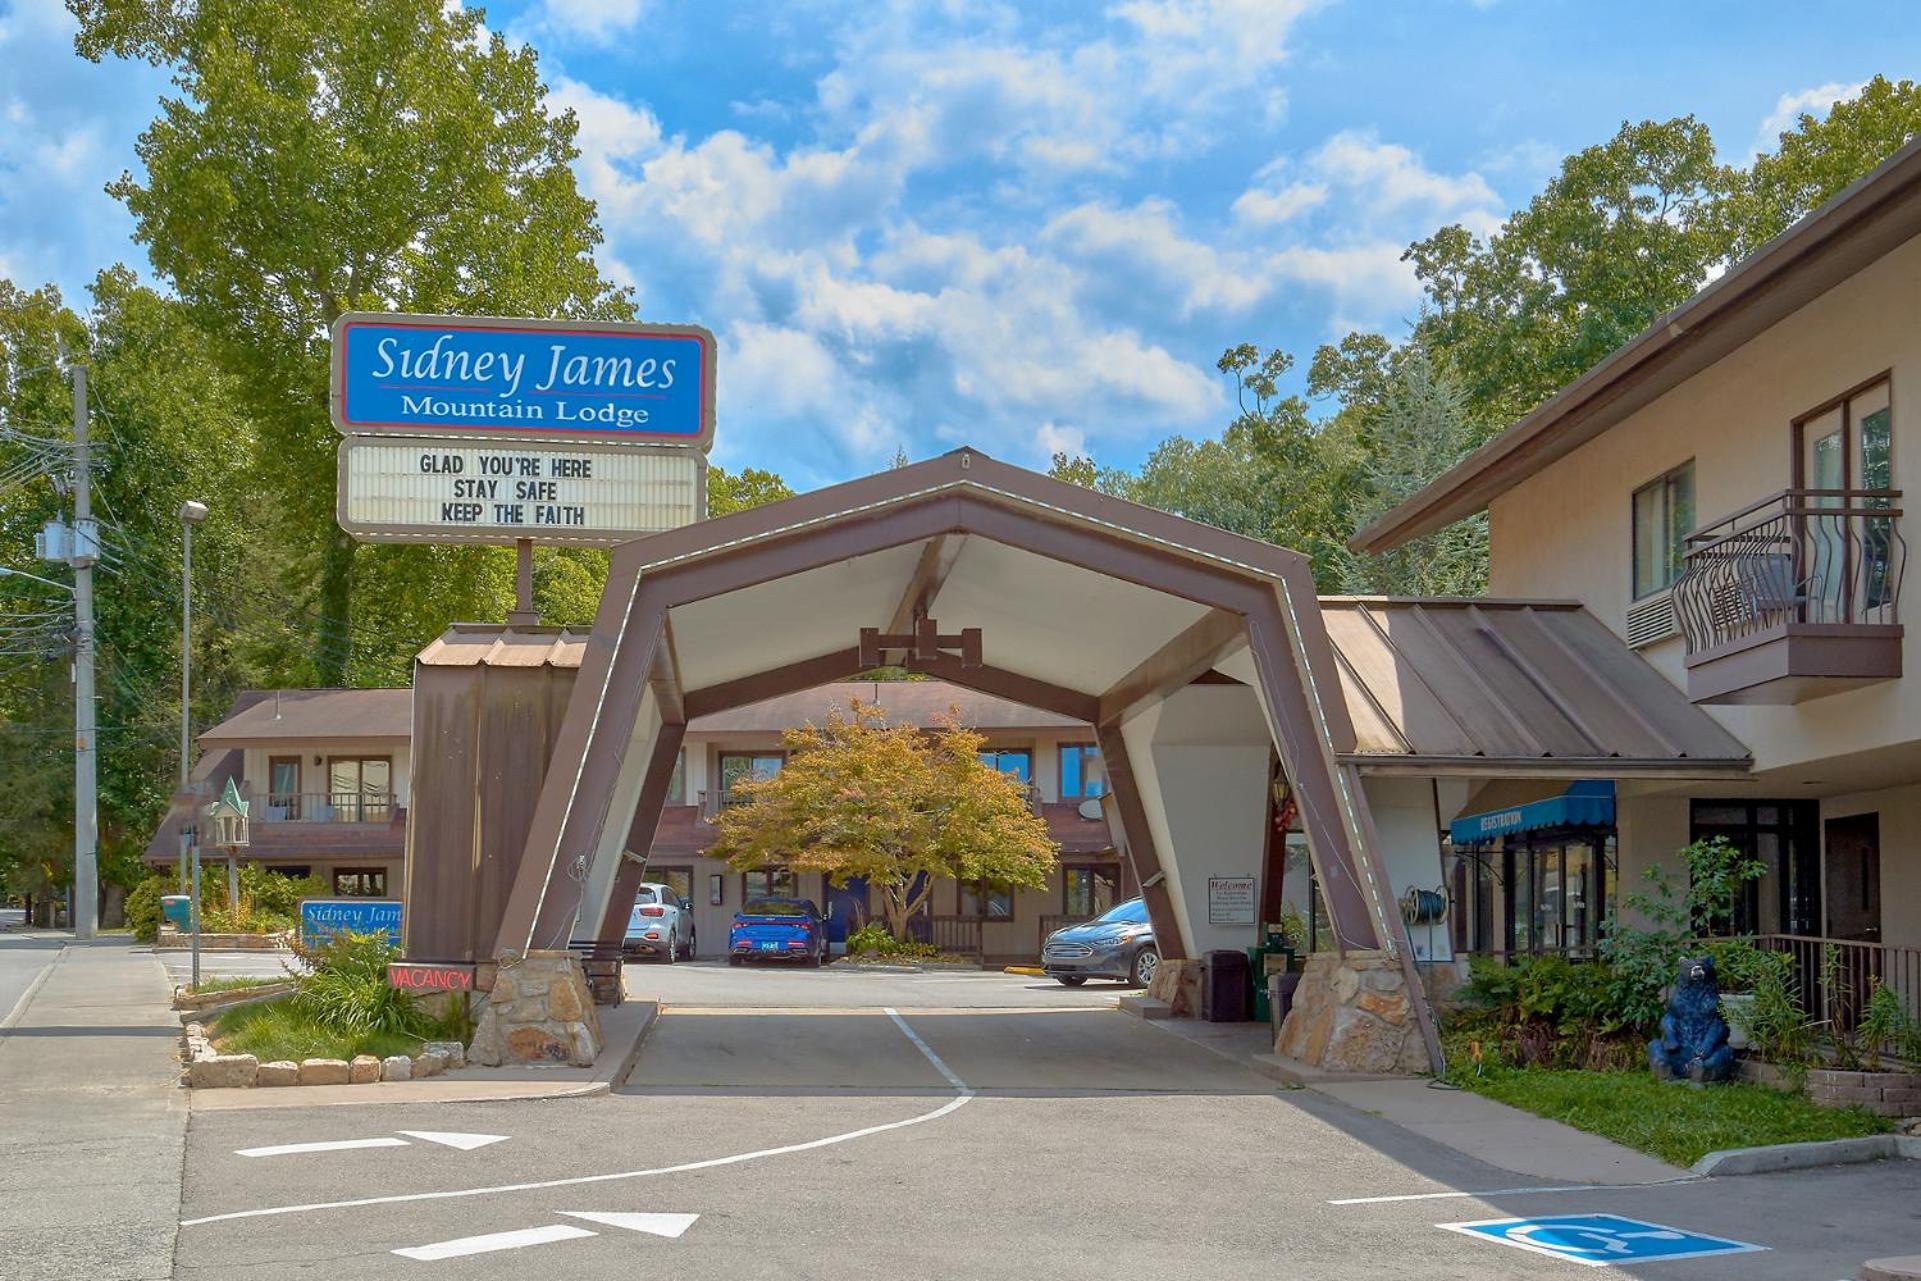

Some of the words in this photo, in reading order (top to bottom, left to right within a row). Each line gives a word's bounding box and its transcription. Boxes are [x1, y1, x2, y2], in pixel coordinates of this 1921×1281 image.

[372, 334, 526, 399] Sidney
[535, 344, 677, 391] James
[400, 395, 543, 420] Mountain
[556, 400, 649, 428] Lodge
[419, 454, 464, 474] GLAD
[479, 456, 541, 477] YOU'RE
[551, 457, 592, 478] HERE
[454, 479, 498, 499] STAY
[516, 481, 557, 501] SAFE
[441, 502, 483, 522] KEEP
[494, 504, 524, 523] THE
[535, 505, 585, 525] FAITH
[1481, 812, 1521, 831] REGISTRATION
[1211, 880, 1253, 890] Welcome
[307, 904, 363, 926] Sidney
[367, 907, 401, 923] Jam
[389, 968, 472, 989] VACANCY
